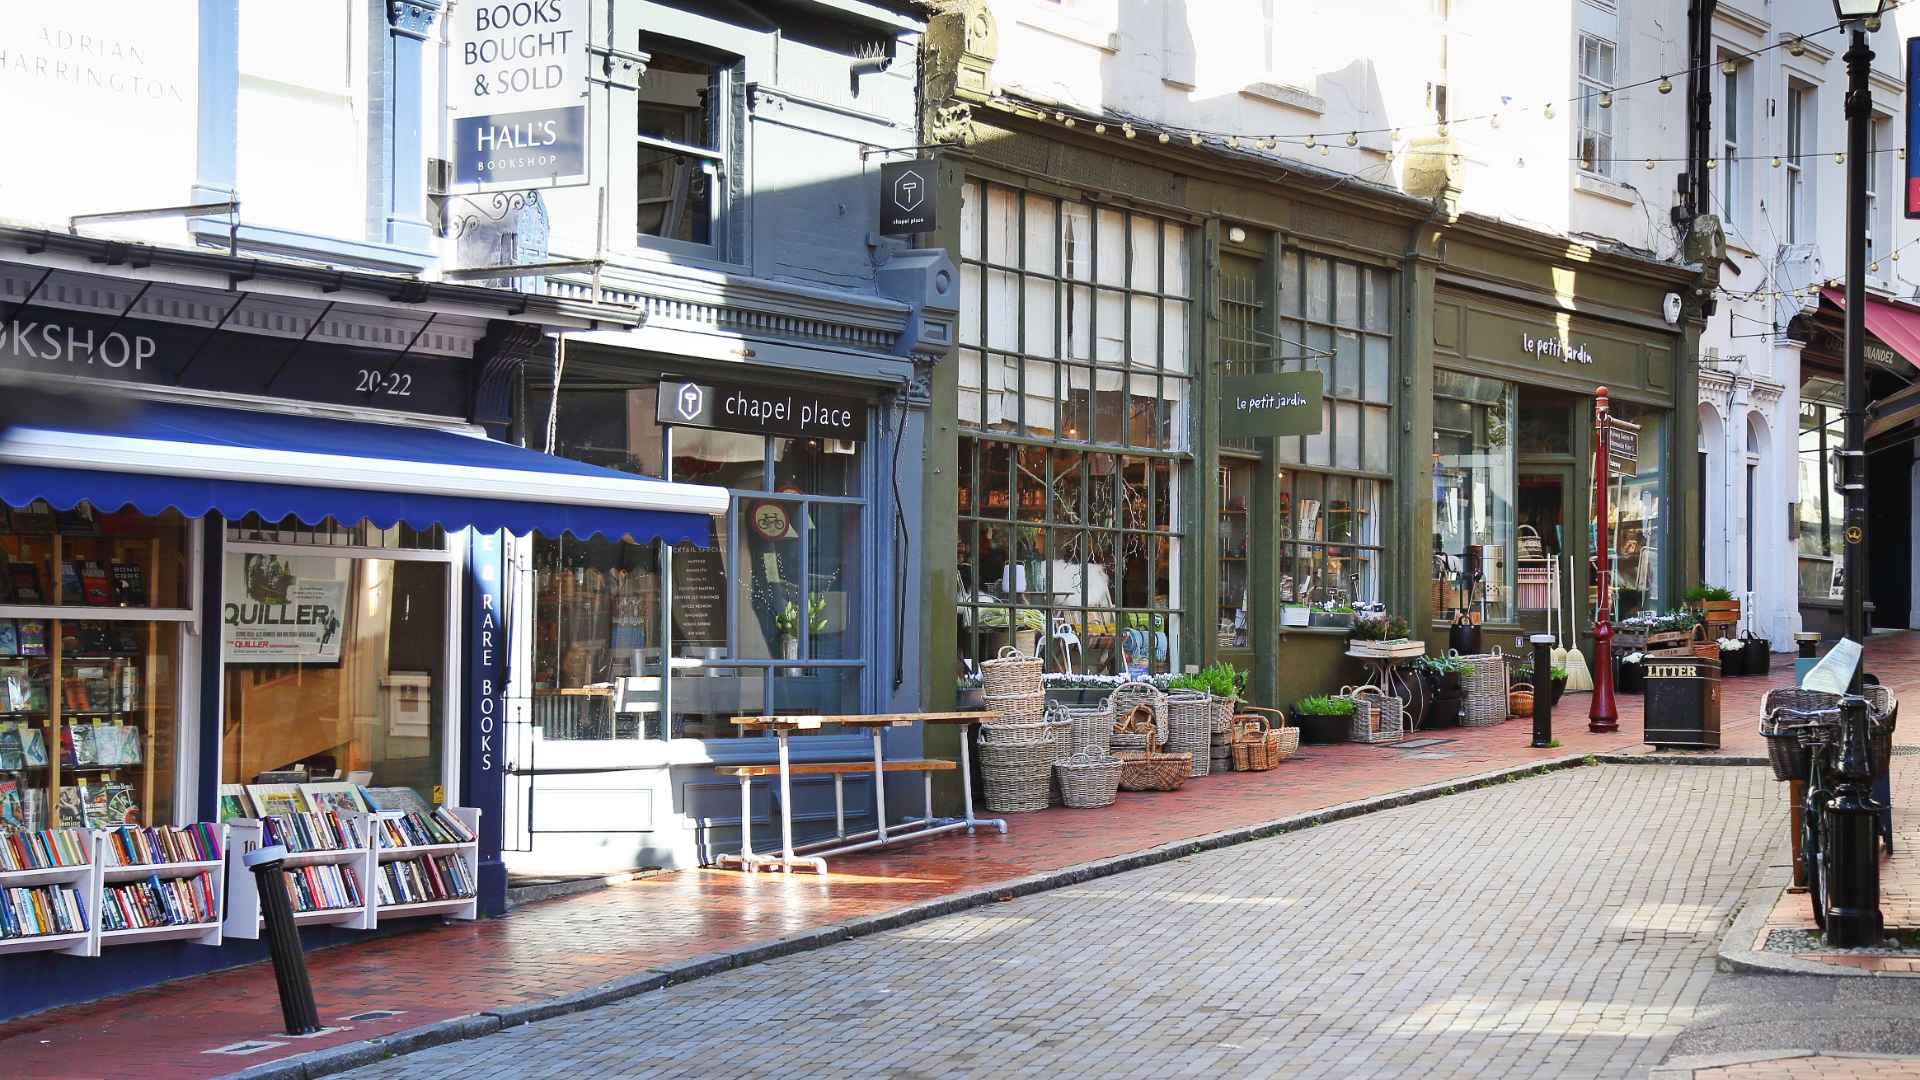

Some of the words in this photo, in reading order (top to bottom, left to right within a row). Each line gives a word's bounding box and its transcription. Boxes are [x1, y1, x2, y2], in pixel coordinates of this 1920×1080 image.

[476, 0, 562, 31] BOOKS
[37, 26, 145, 65] ADRIAN
[465, 30, 573, 65] BOUGHT
[474, 73, 490, 97] &
[497, 65, 564, 95] SOLD
[477, 120, 557, 152] HALL'S
[478, 155, 557, 171] BOOKSHOP
[0, 319, 156, 371] KSHOP
[1523, 332, 1534, 352] le
[1537, 337, 1562, 361] petit
[1864, 345, 1894, 364] NANDEZ
[355, 369, 412, 396] 20-22
[725, 391, 791, 424] chapel
[801, 400, 852, 429] place
[1236, 397, 1247, 410] le
[1248, 393, 1275, 414] petit
[1275, 391, 1307, 410] jardin
[224, 603, 330, 626] QUILLER
[482, 593, 495, 666] RARE
[1647, 664, 1697, 677] LITTER
[481, 680, 494, 770] BOOKS
